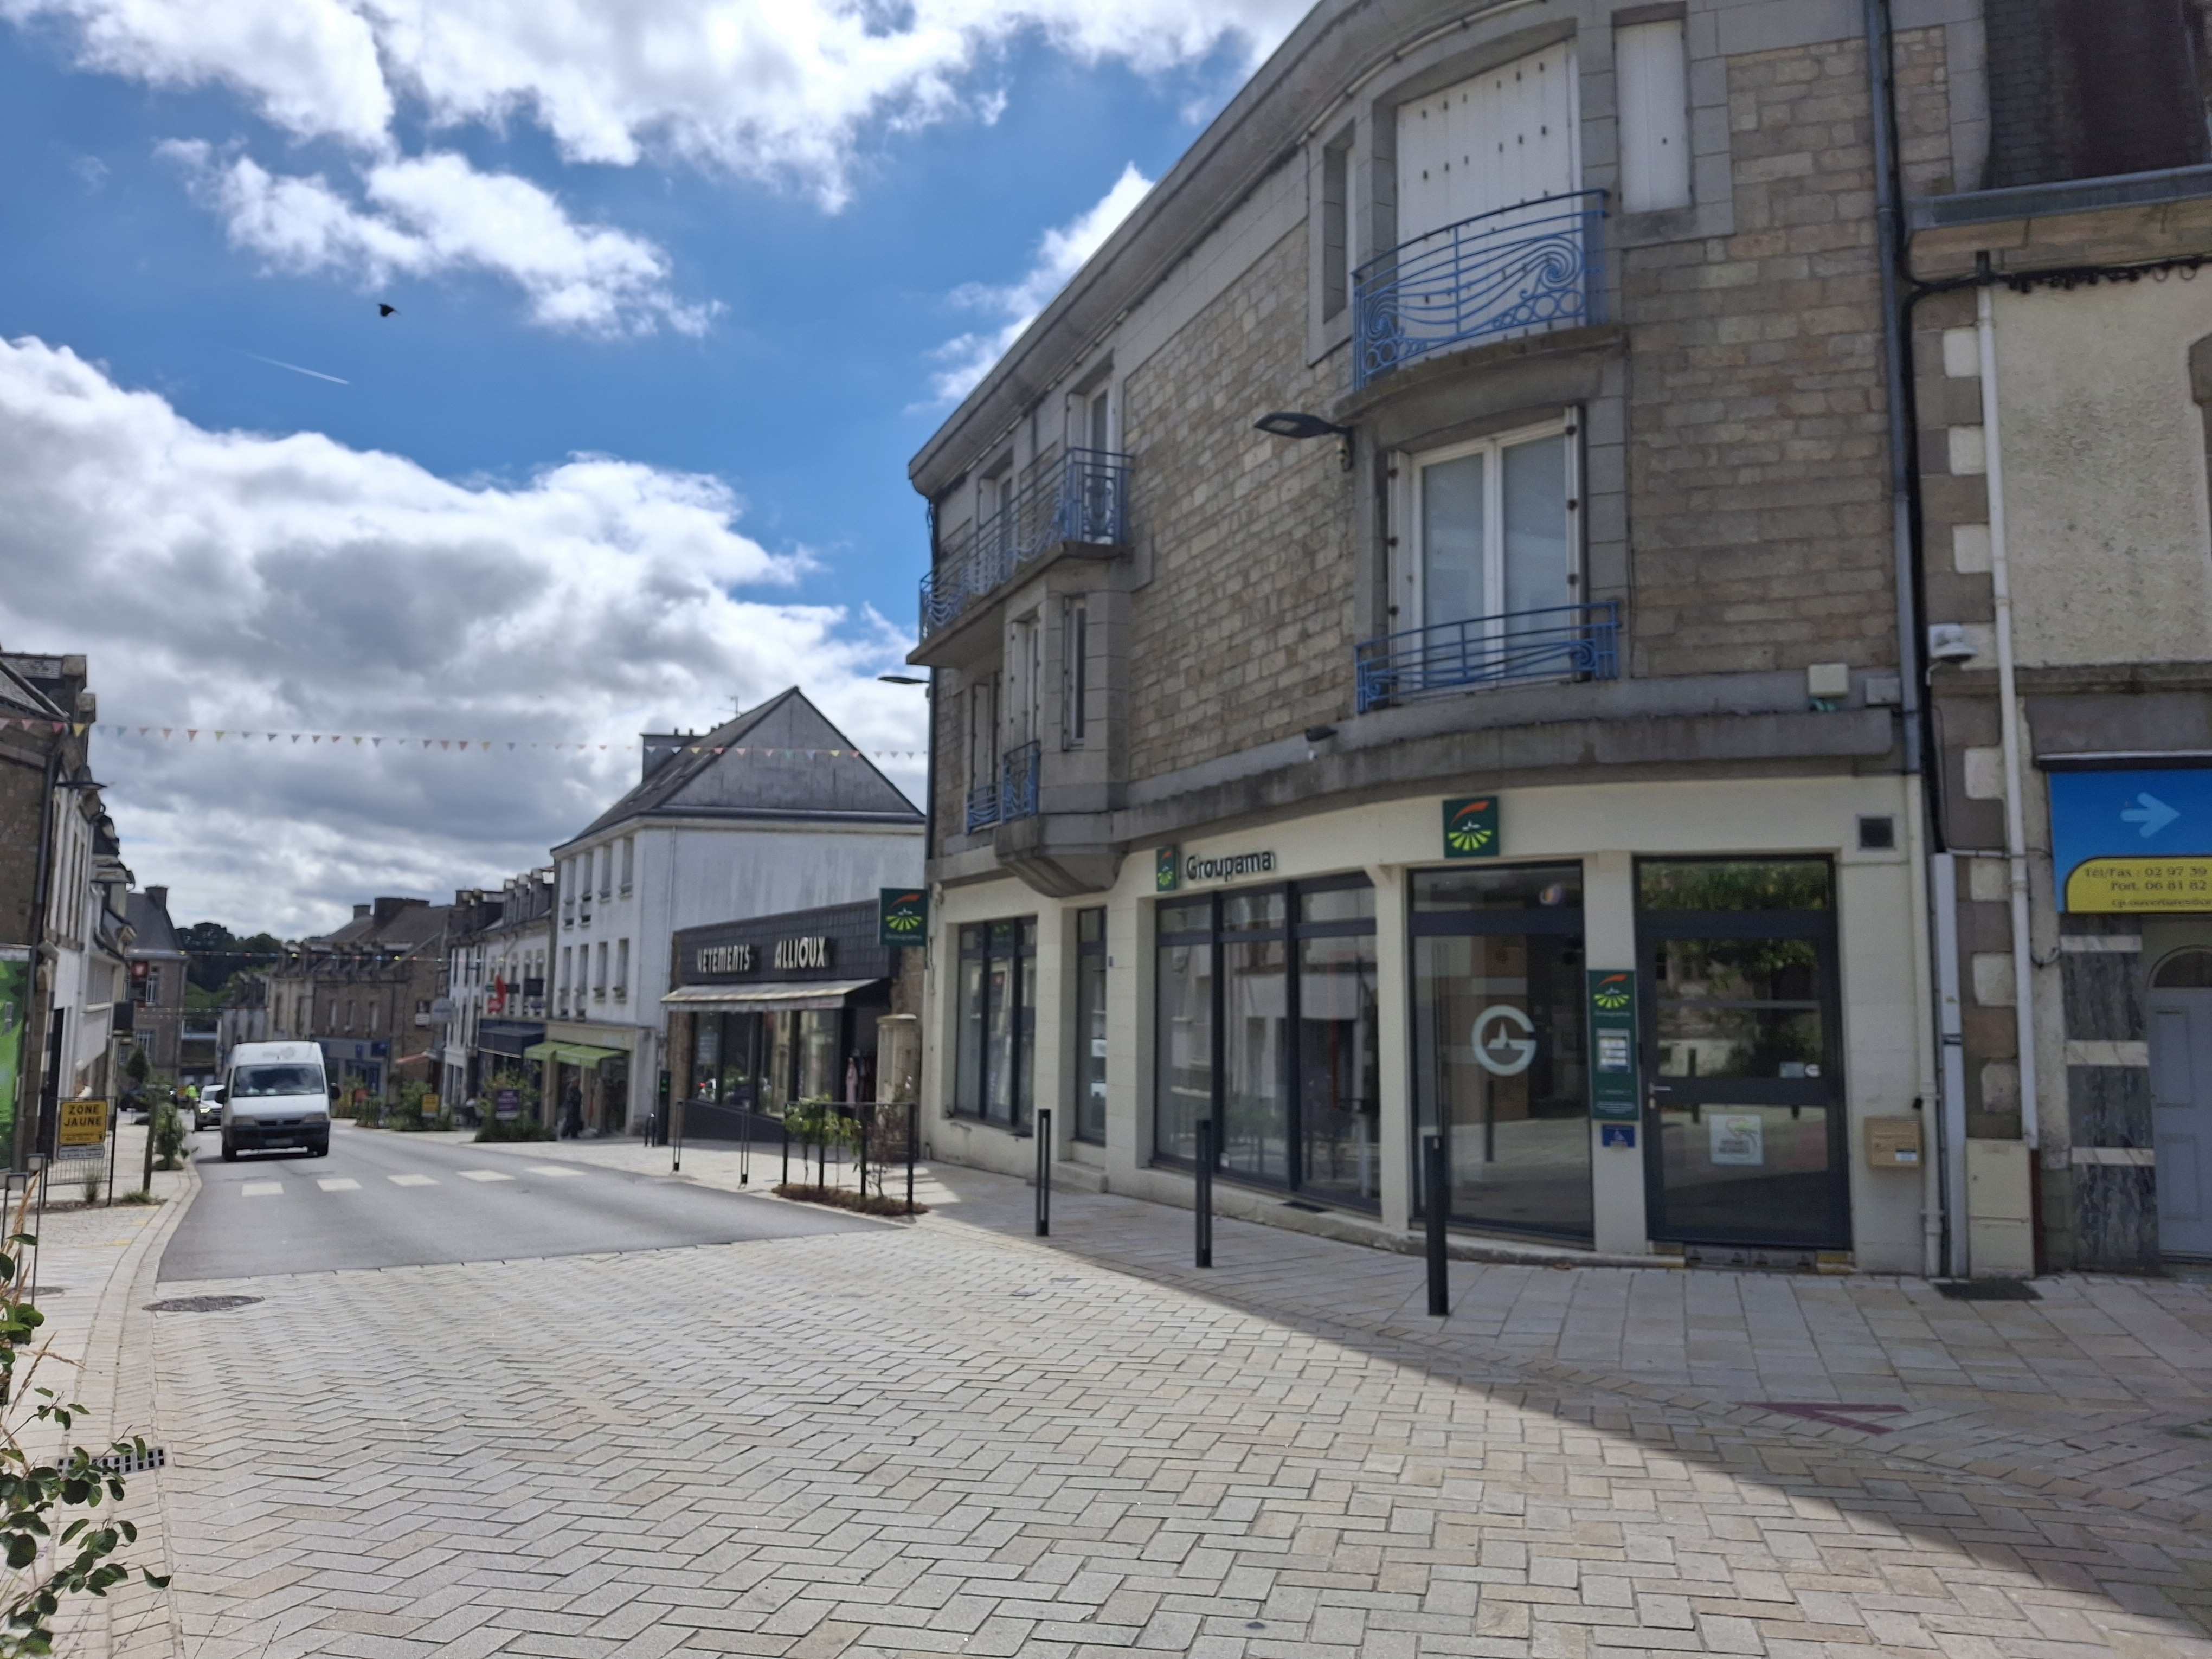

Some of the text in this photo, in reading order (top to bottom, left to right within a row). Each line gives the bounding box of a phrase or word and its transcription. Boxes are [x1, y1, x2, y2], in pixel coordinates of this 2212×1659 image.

[1186, 850, 1275, 882] Groupama
[2144, 867, 2163, 878] 02
[774, 936, 826, 969] ALLIOUX
[68, 1104, 99, 1115] ZONE
[63, 1116, 102, 1127] JAUNE
